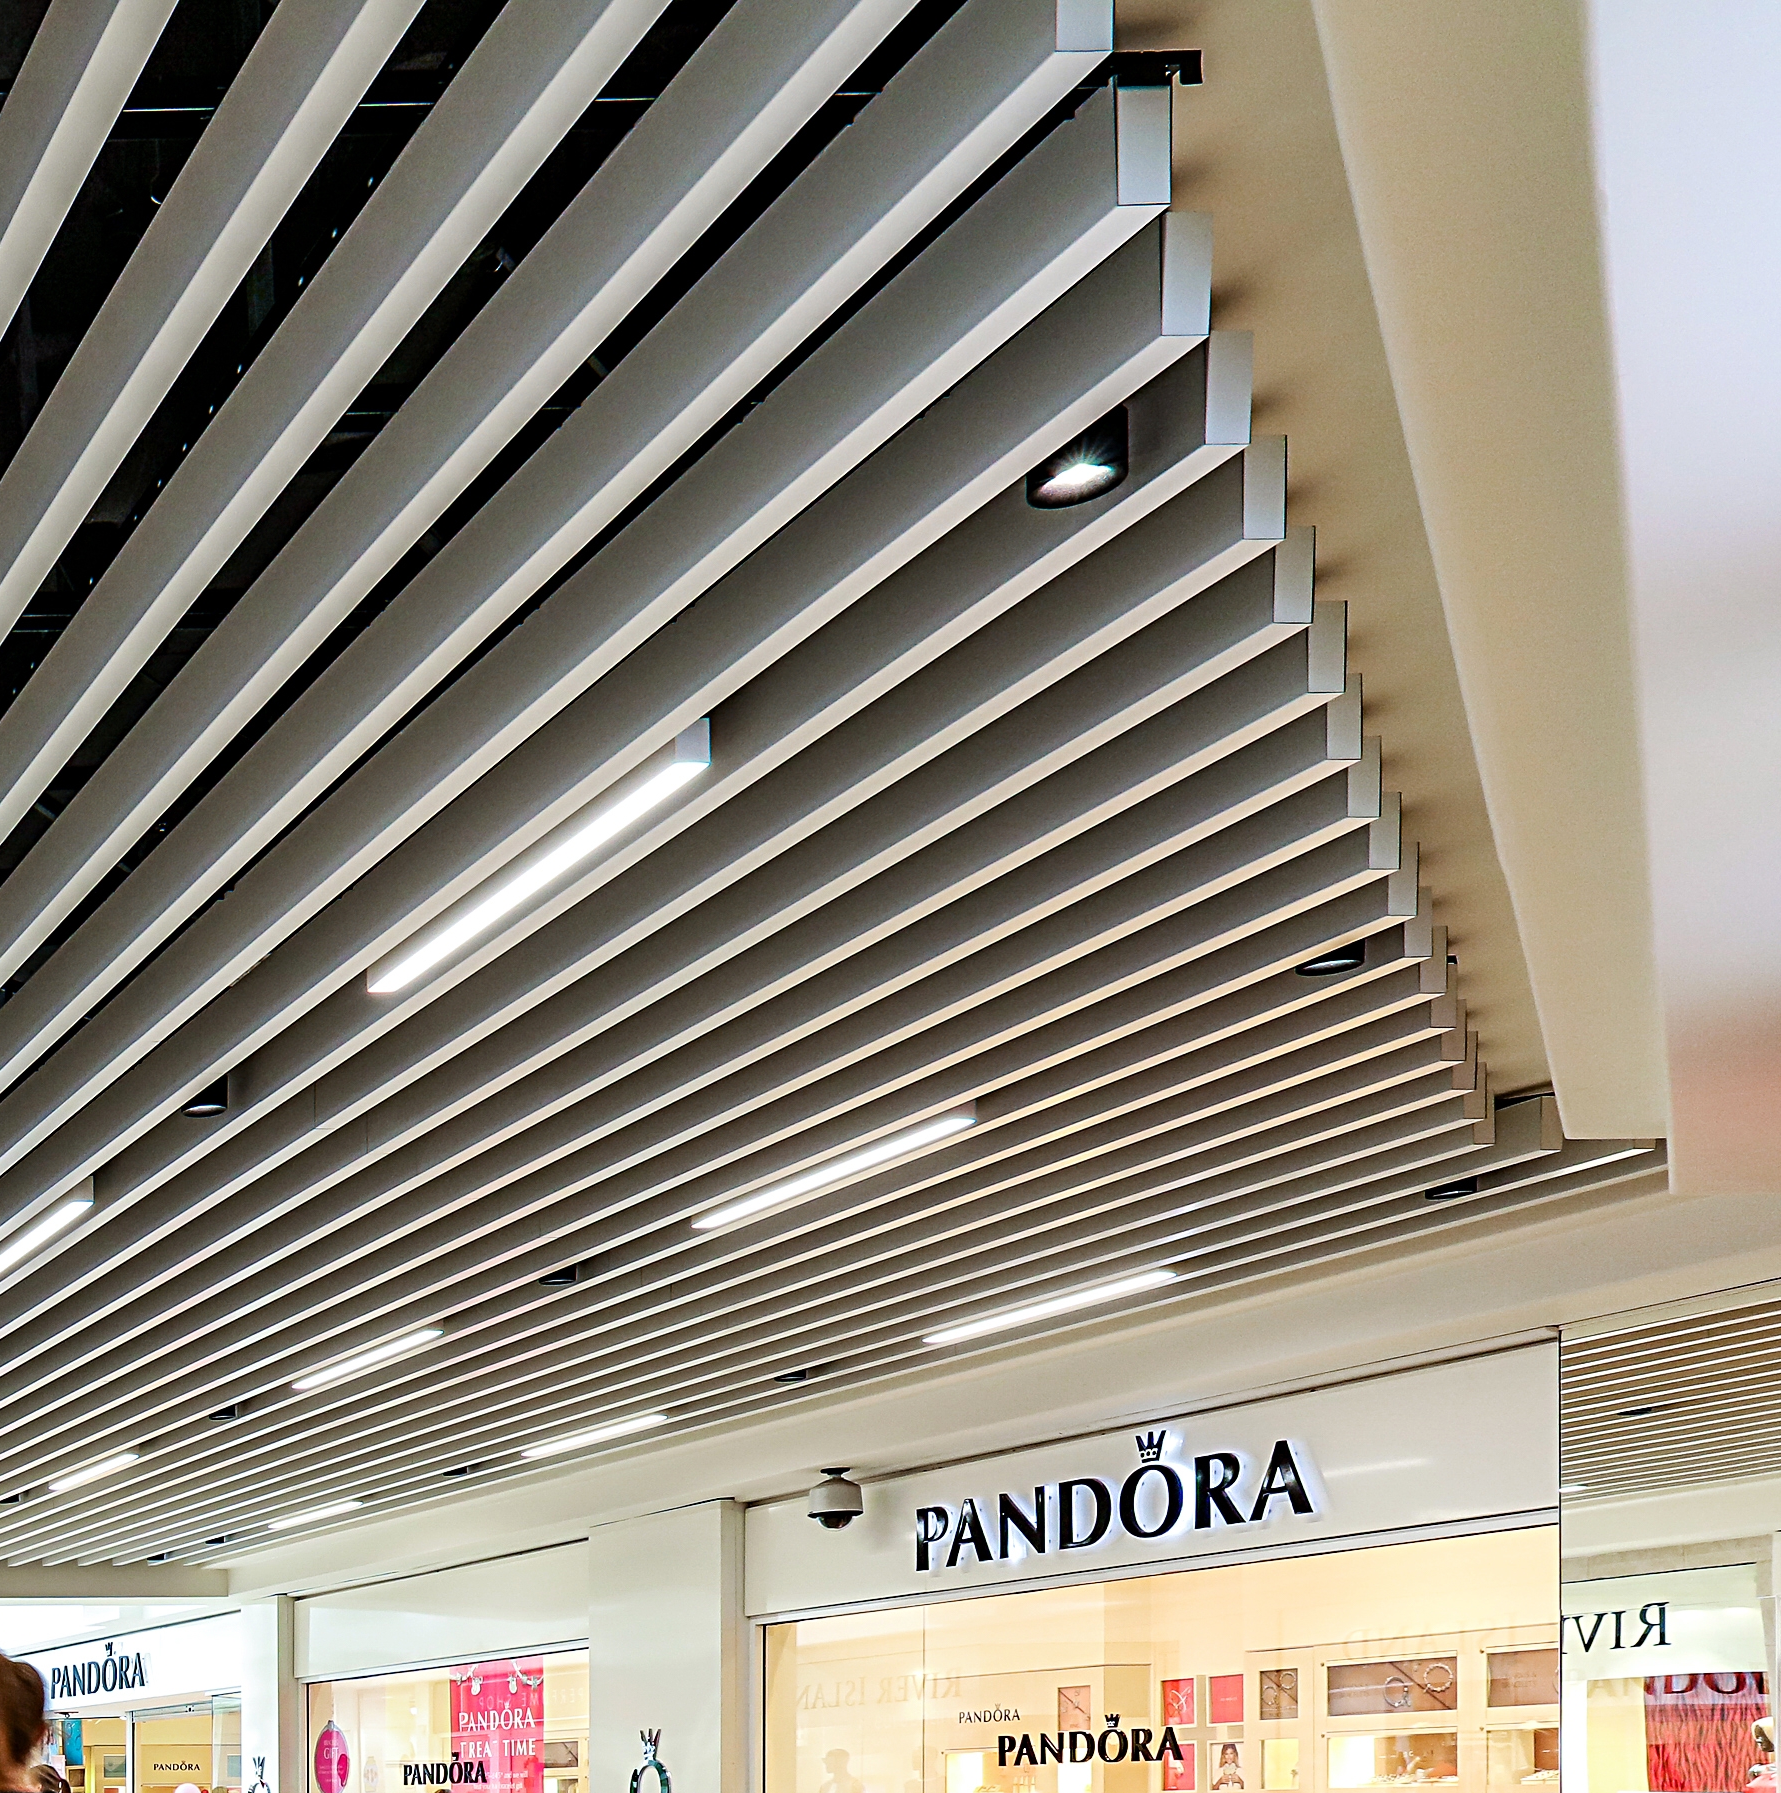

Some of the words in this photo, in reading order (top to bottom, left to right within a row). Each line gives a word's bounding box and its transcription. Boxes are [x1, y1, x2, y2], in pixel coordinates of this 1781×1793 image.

[915, 1432, 1315, 1572] PANDORA
[51, 1649, 146, 1700] PANDORA
[458, 1704, 536, 1732] PANDORA
[958, 1705, 1021, 1725] PANDORA
[323, 1747, 339, 1760] GIFT
[460, 1739, 498, 1759] TREA
[502, 1738, 536, 1757] TIME
[997, 1720, 1184, 1767] PANDORA
[153, 1761, 201, 1771] PANDORA
[403, 1757, 488, 1786] PANDORA
